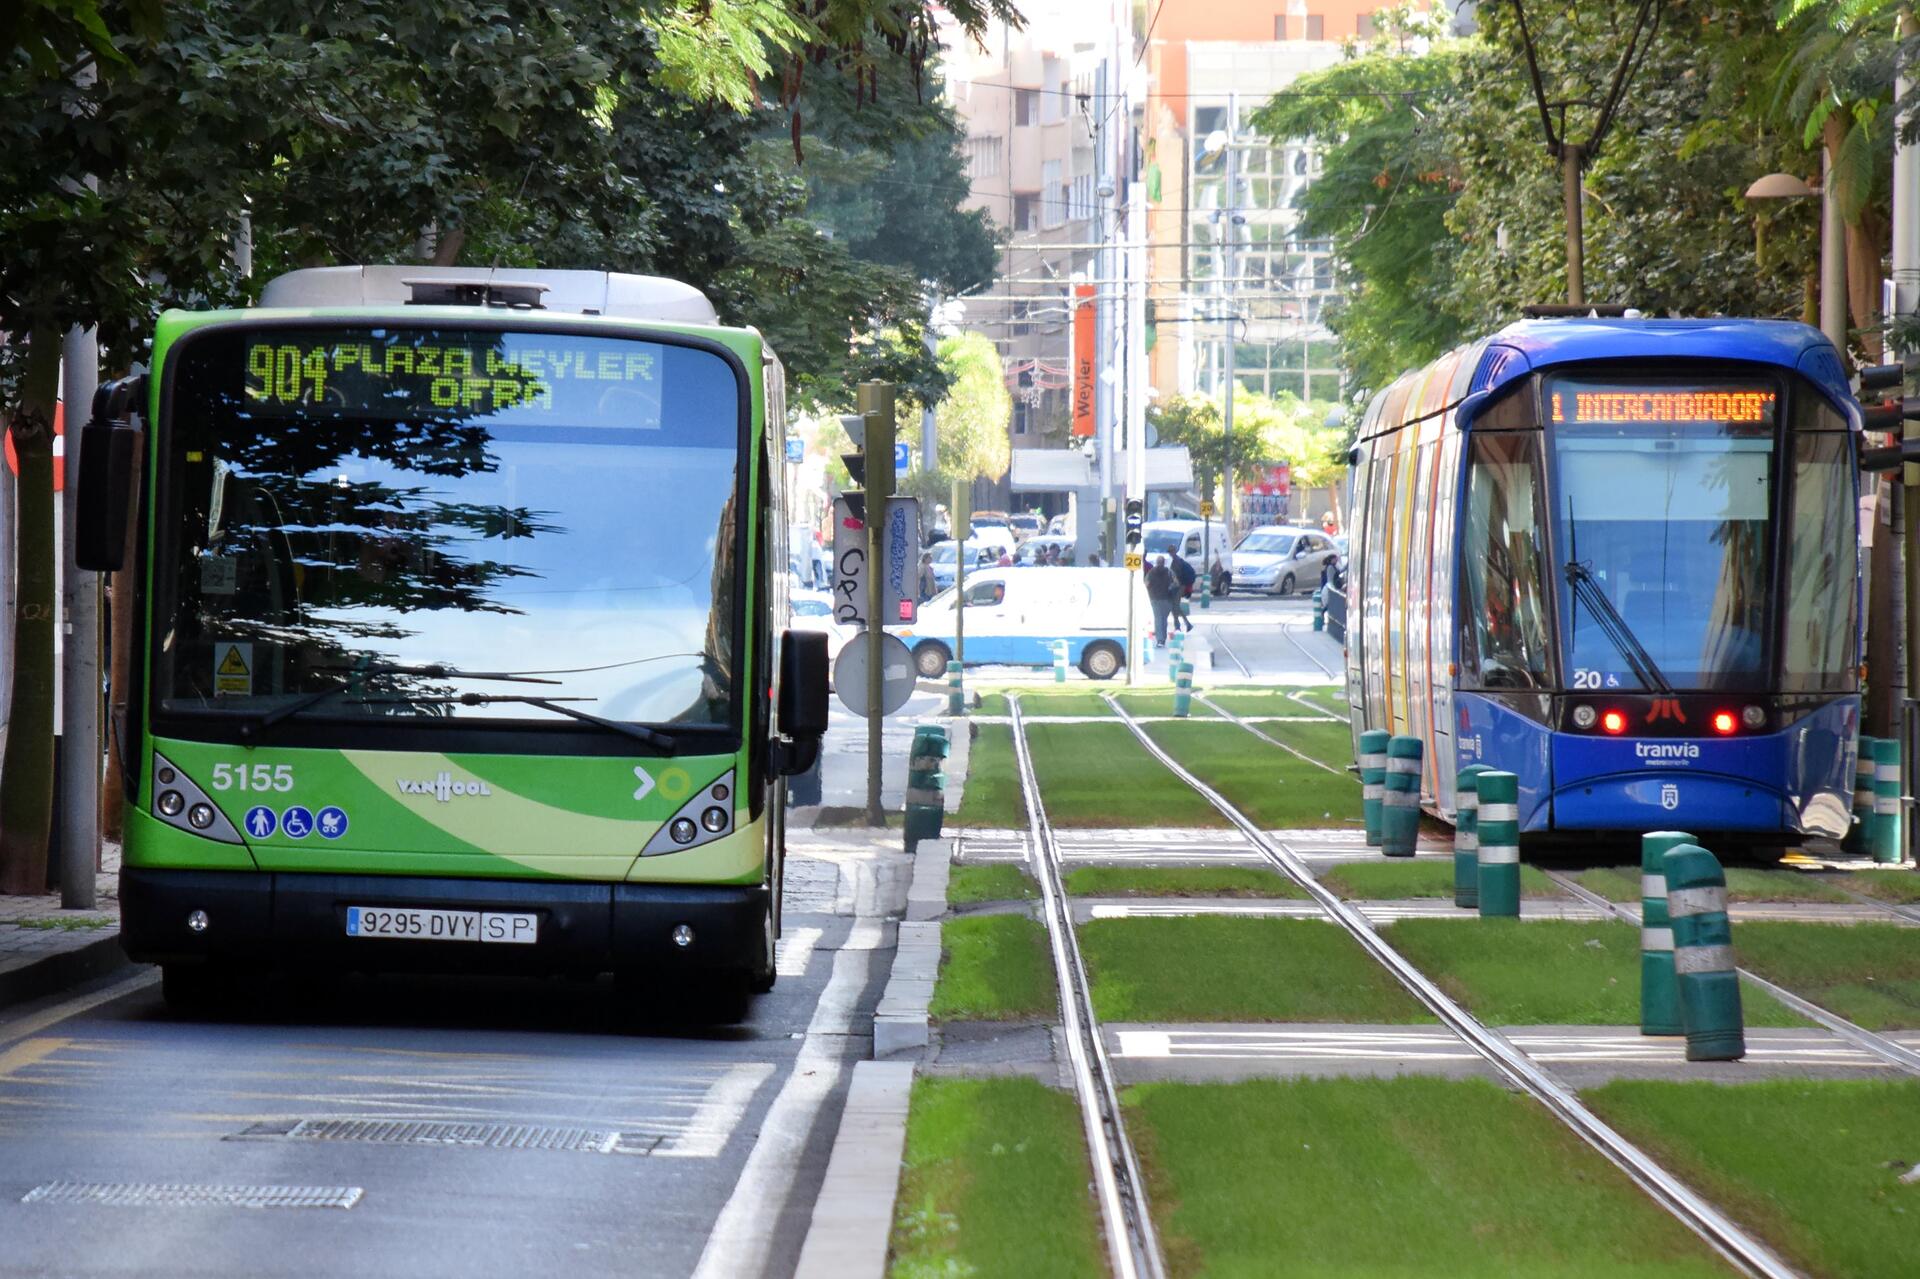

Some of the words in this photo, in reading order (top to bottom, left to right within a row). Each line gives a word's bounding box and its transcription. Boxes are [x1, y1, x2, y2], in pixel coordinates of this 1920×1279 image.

[249, 344, 328, 402] 904
[334, 343, 473, 377] PLAZA
[486, 348, 655, 381] WEYLER
[430, 378, 552, 410] OFRA
[1076, 358, 1094, 418] Weyler
[1551, 393, 1565, 421] 1
[1126, 556, 1142, 567] 20
[1574, 671, 1602, 689] 20
[1635, 742, 1700, 758] tranvia
[212, 763, 294, 792] 5155
[364, 912, 422, 934] 9295
[430, 915, 474, 937] DVY
